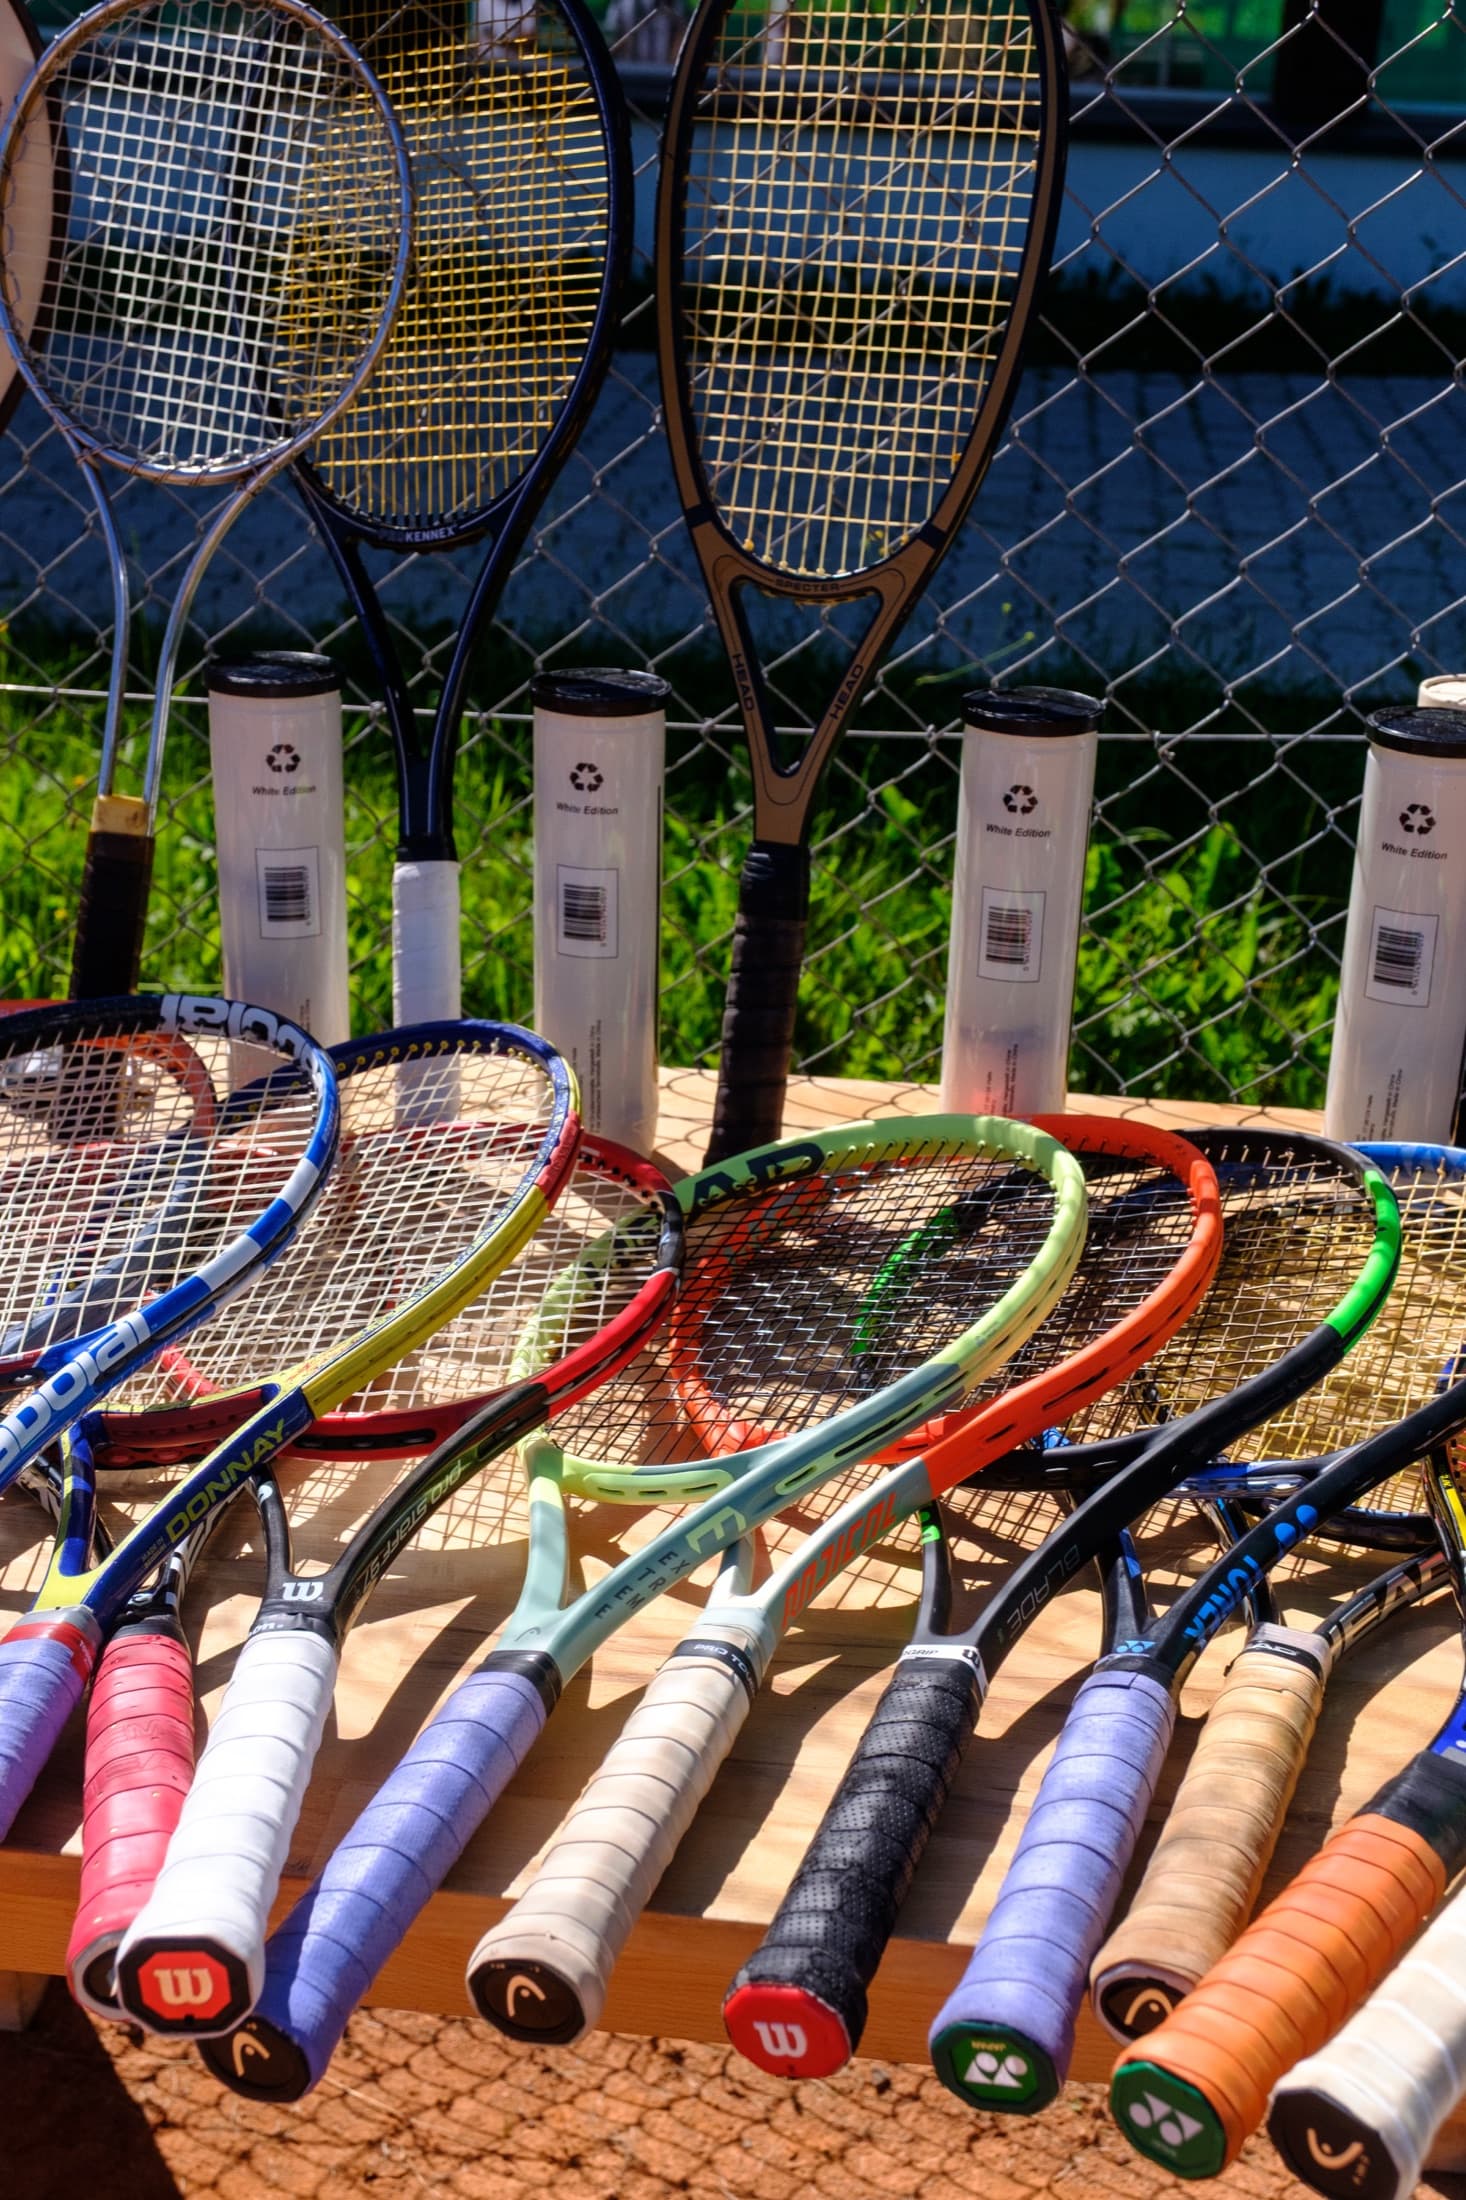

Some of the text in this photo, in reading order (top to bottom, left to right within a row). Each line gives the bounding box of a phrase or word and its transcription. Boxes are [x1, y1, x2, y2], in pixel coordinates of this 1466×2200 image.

[404, 525, 457, 542] KENNEX
[775, 578, 841, 593] SPECTER
[732, 653, 755, 712] HEAD
[829, 664, 864, 720] HEAD
[252, 785, 280, 796] White
[556, 802, 619, 816] White Edition
[985, 823, 1051, 839] White Edition
[1381, 842, 1448, 861] White Edition
[164, 1418, 288, 1543] DONNAY
[782, 1490, 898, 1631] RADICAL
[1005, 1543, 1081, 1639] BLADE
